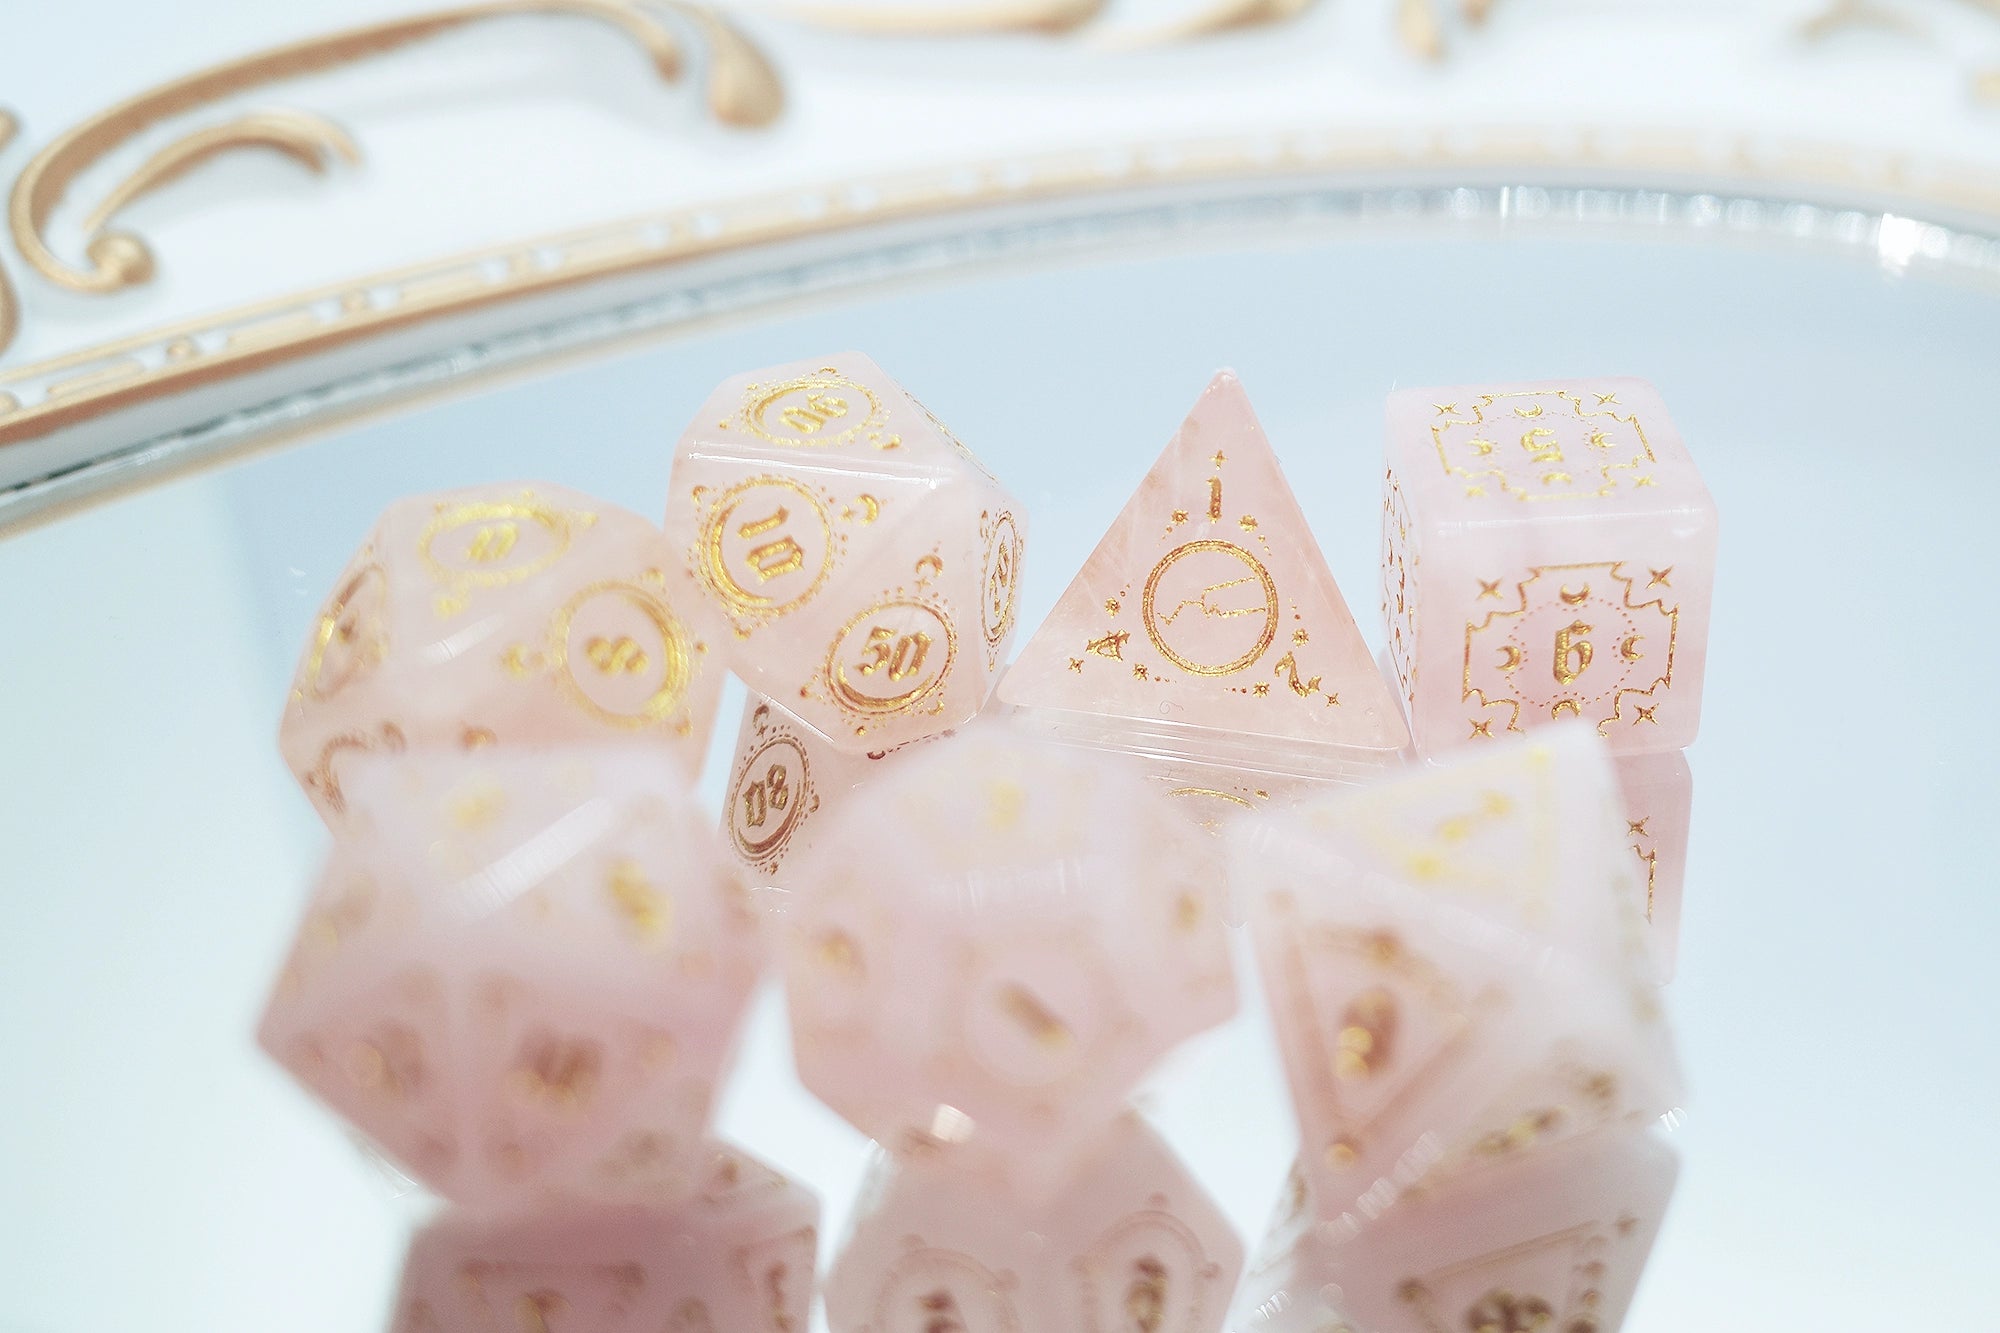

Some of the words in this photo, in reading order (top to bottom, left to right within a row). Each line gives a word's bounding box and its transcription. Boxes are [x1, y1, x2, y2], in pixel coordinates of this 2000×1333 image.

[1520, 426, 1566, 463] 5
[1206, 475, 1223, 523] 1
[737, 504, 807, 584] 10
[853, 625, 936, 682] 50
[1274, 650, 1322, 698] 2
[1552, 619, 1594, 686] 6
